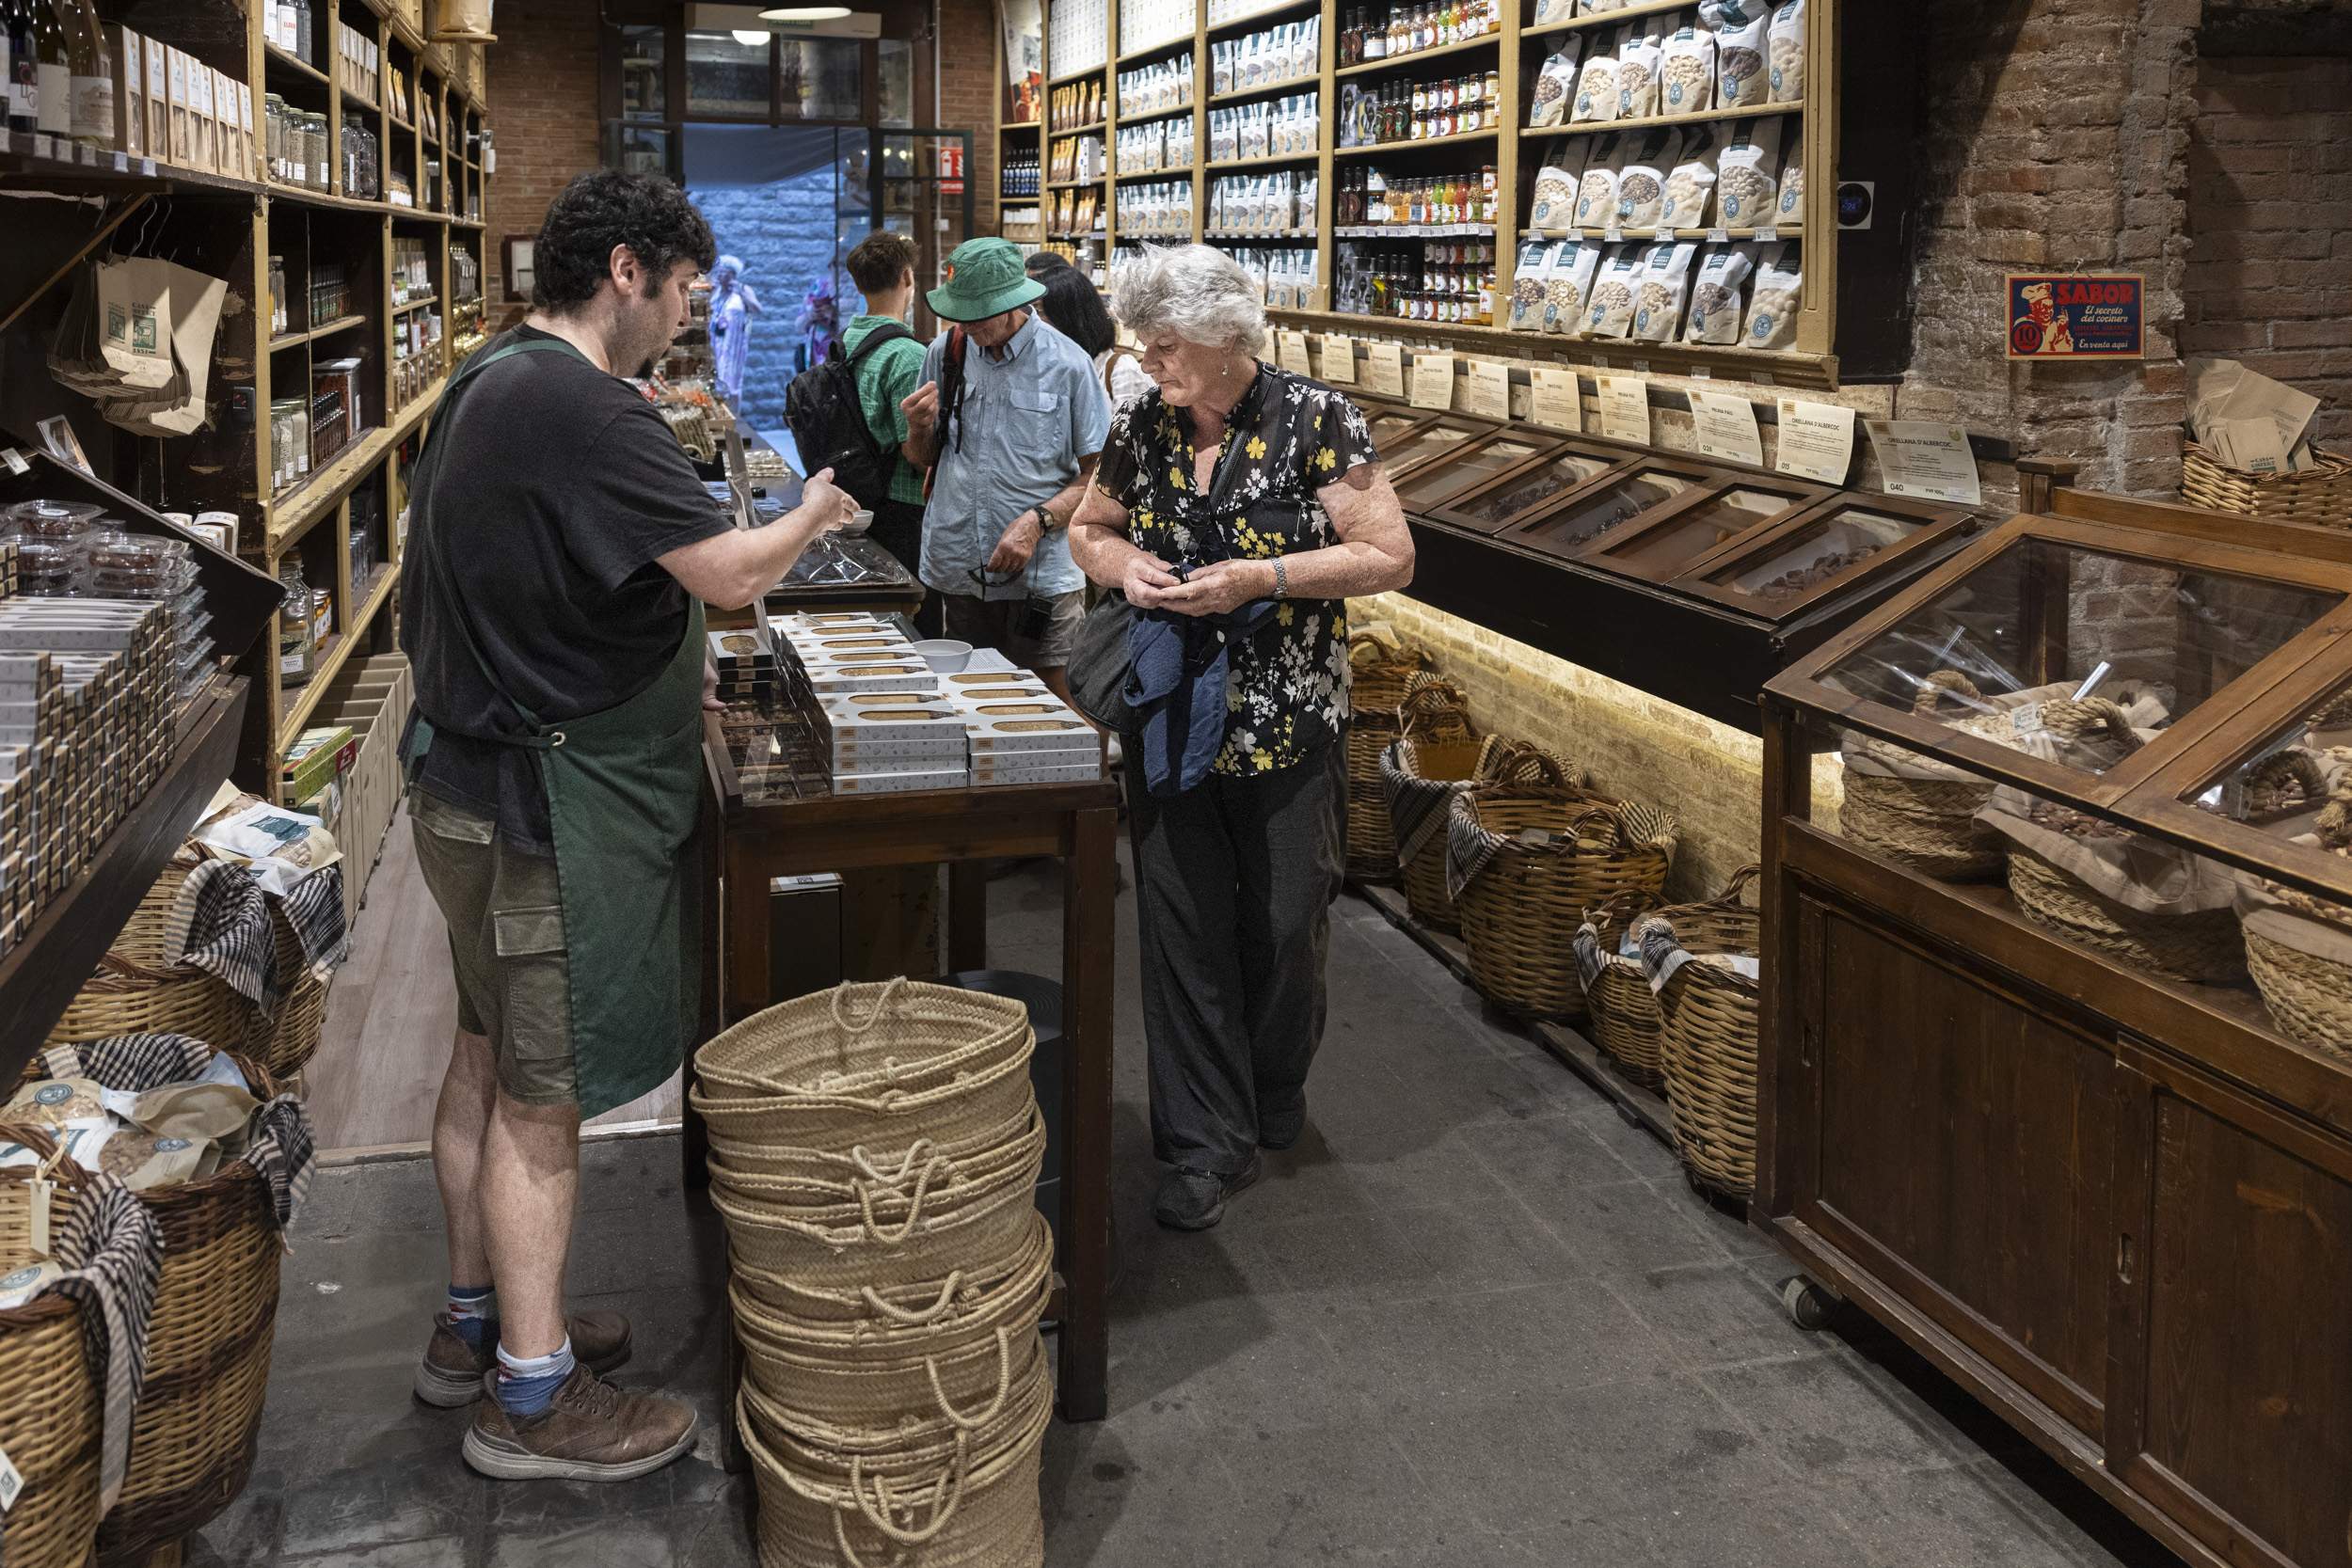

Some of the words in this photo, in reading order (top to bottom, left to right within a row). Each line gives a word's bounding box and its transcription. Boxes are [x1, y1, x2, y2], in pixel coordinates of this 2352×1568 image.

[2057, 284, 2134, 305] SABOR
[2085, 306, 2094, 314] El
[2094, 307, 2123, 315] secreto
[2079, 339, 2089, 349] En
[2090, 341, 2111, 349] venta
[1890, 483, 1904, 491] 040
